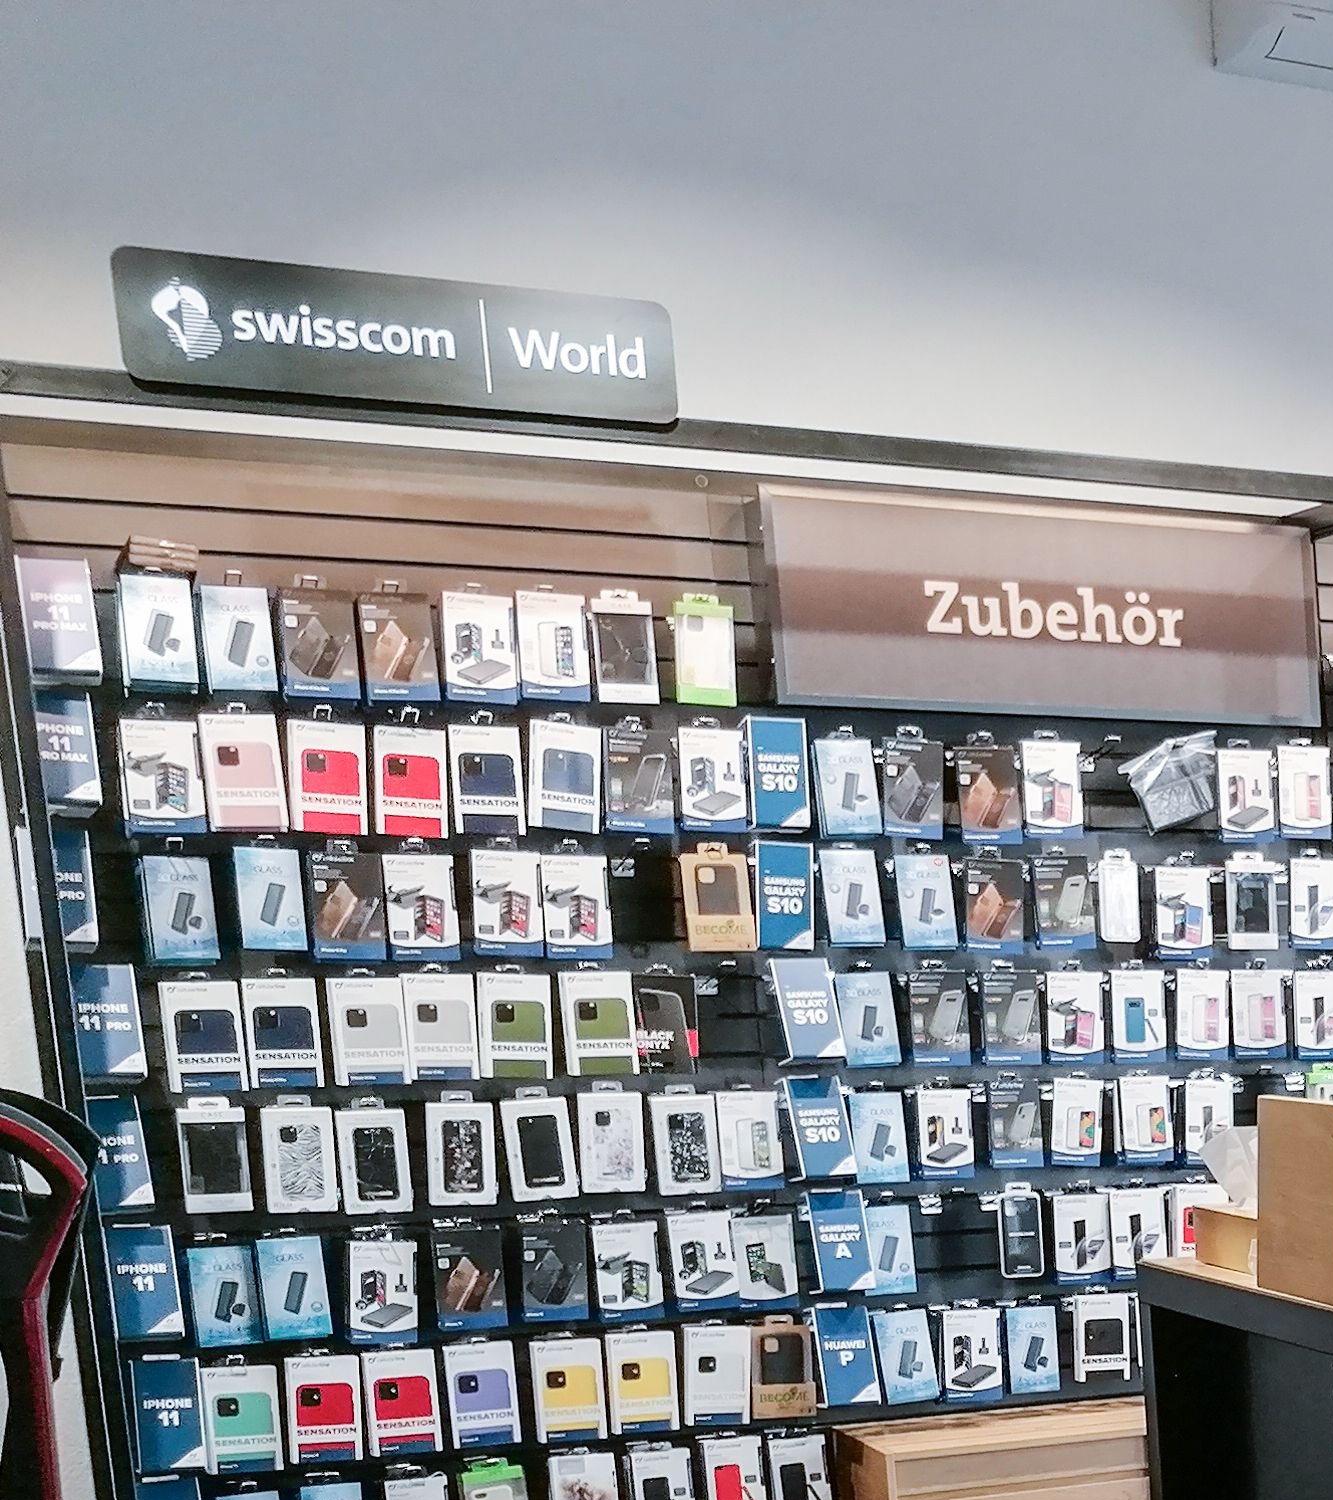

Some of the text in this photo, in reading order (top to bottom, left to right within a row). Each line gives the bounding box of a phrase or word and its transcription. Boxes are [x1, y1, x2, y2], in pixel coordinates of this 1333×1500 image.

[231, 304, 648, 380] swisscom World
[30, 590, 83, 604] IPHONE
[47, 604, 71, 621] 11
[923, 580, 1185, 648] Zubehör
[33, 620, 88, 633] PRO MAX
[37, 722, 85, 735] PHONE
[48, 735, 72, 751] 11
[61, 752, 89, 763] MAX
[757, 763, 800, 774] GALAXY
[762, 774, 799, 793] S10
[301, 796, 363, 807] SENSATION
[382, 799, 443, 811] SENSATION
[460, 797, 520, 808] SENSATION
[540, 793, 595, 806] SENSATION
[764, 885, 807, 898] GALAXY
[767, 897, 804, 915] S10
[78, 1002, 129, 1014] IPHONE
[79, 1013, 132, 1032] 11 PRO
[792, 1008, 829, 1025] S10
[491, 1043, 548, 1053] SENSATION
[177, 1055, 242, 1065] SENSATION
[254, 1050, 318, 1061] SENSATION
[799, 1116, 841, 1127] GALAXY
[804, 1126, 842, 1144] S10
[113, 1152, 140, 1164] PRO
[819, 1232, 862, 1243] GALAXY
[835, 1242, 853, 1259] A
[116, 1263, 169, 1276] IPHONE
[131, 1275, 156, 1292] 11
[823, 1339, 867, 1351] HUAWEI
[839, 1350, 855, 1367] P
[143, 1398, 194, 1411] IPHONE
[157, 1410, 182, 1428] 11
[376, 1418, 438, 1431] SENSATION
[297, 1426, 358, 1438] SENSATION
